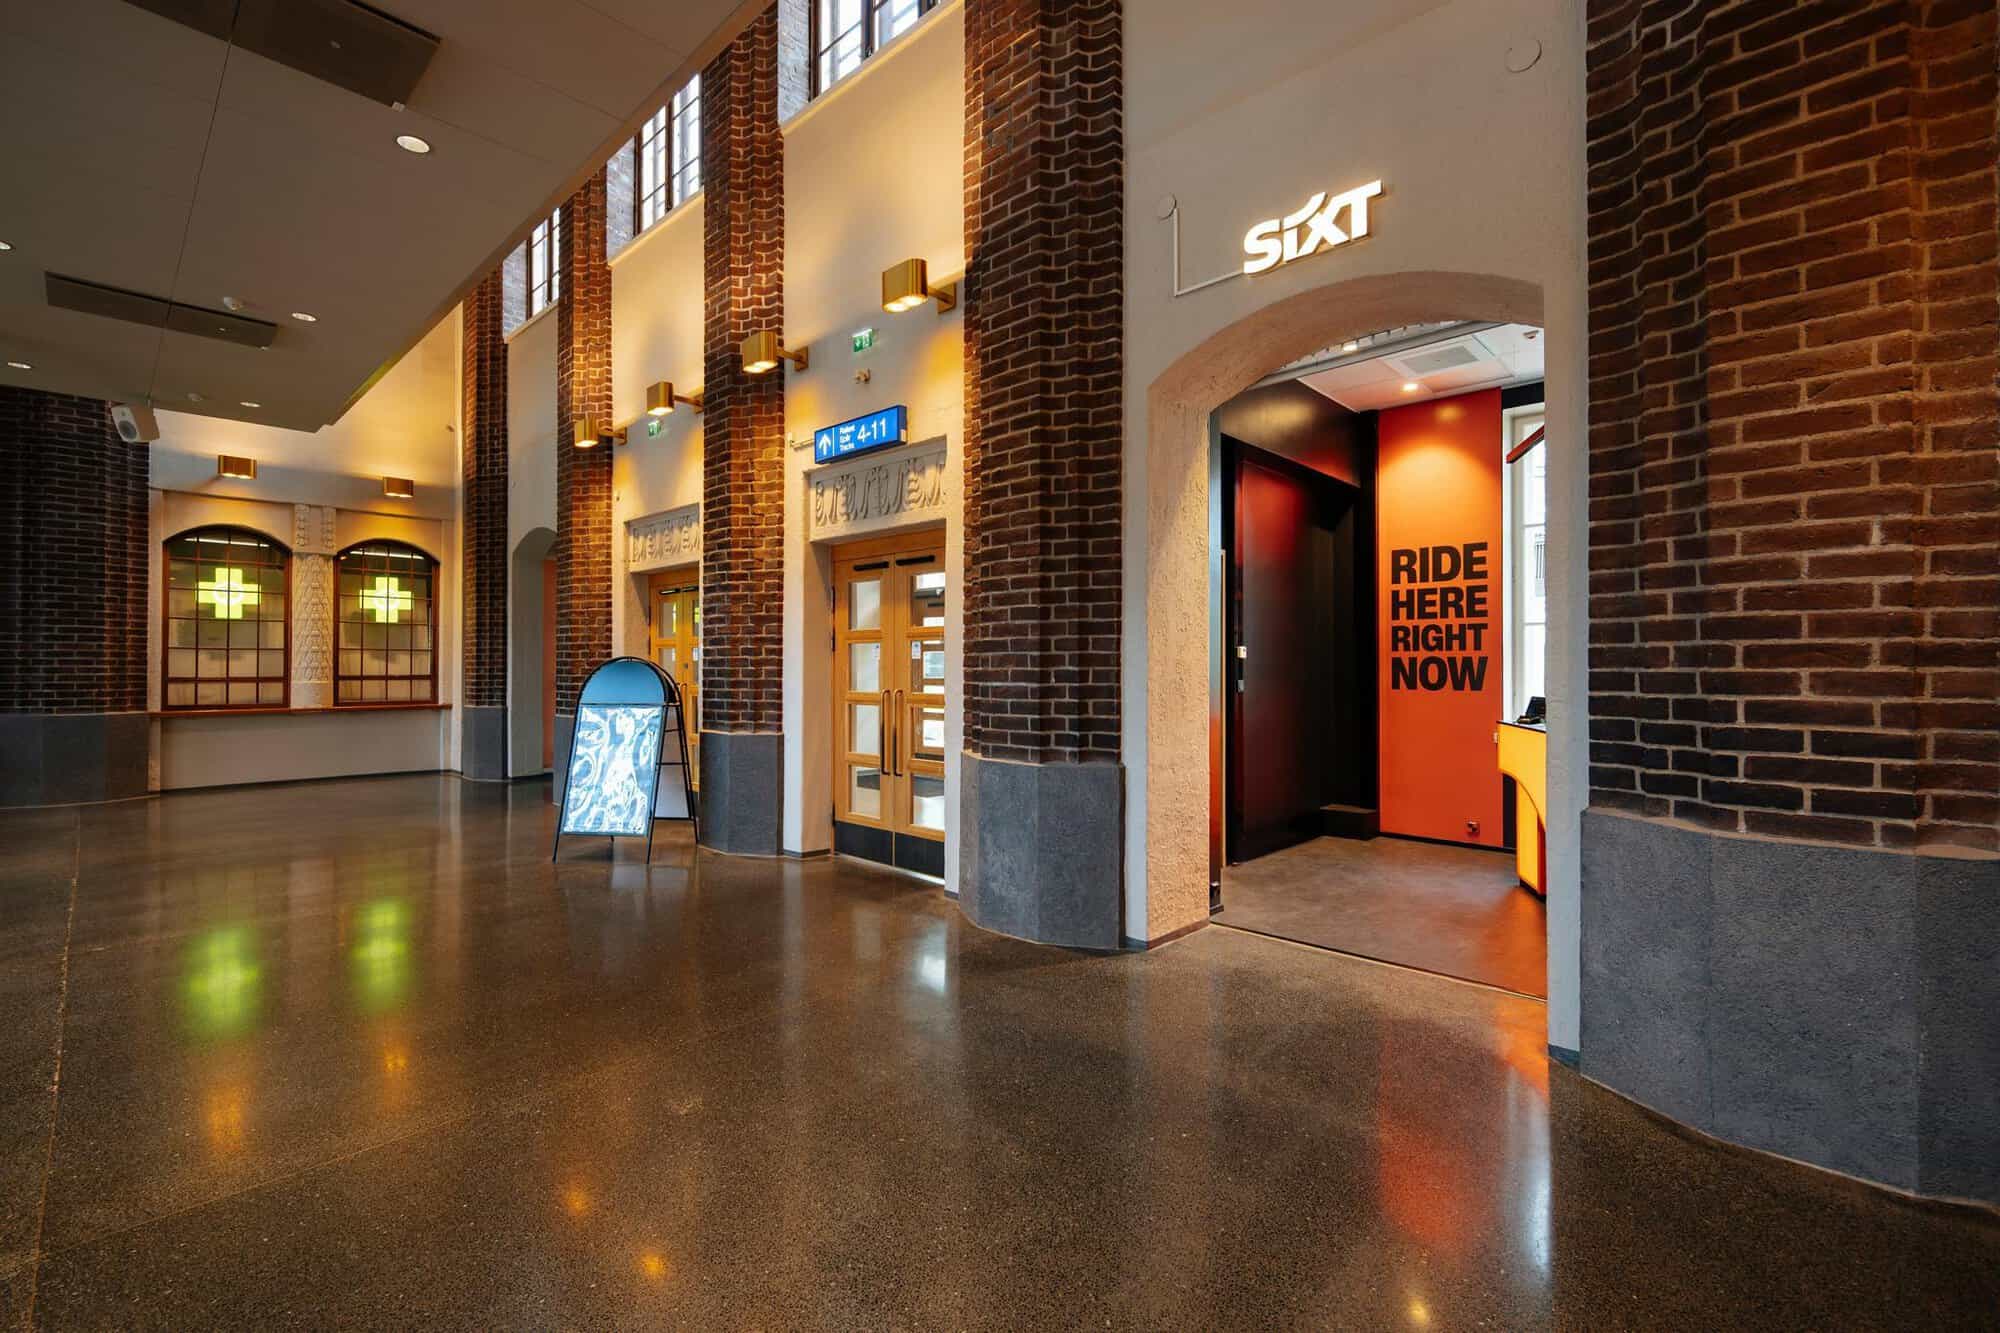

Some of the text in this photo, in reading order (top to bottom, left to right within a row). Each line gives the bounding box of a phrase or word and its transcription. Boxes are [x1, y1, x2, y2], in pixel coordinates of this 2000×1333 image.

[857, 417, 887, 443] 4-11
[1391, 542, 1489, 585] RIDE
[1391, 584, 1489, 620] HERE
[1391, 623, 1489, 652] RIGHT
[1391, 656, 1489, 692] NOW
